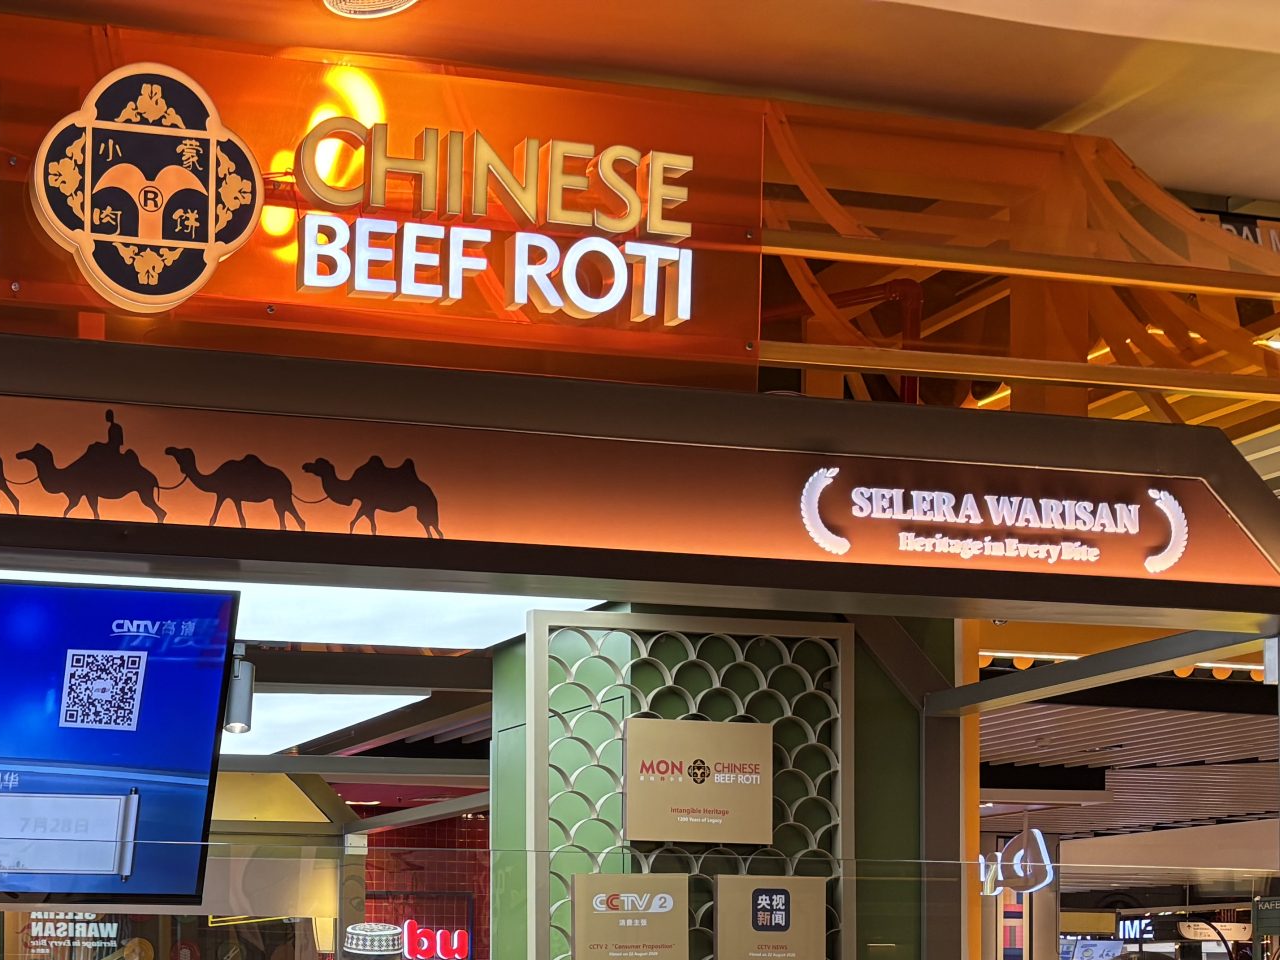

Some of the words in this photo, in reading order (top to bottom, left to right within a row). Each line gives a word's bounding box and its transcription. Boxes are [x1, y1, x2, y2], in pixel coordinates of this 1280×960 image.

[295, 116, 694, 240] CHINESE
[299, 214, 489, 301] BEEF
[511, 233, 693, 324] ROTI
[851, 487, 982, 525] SELERA
[984, 495, 1140, 535] WARISAN
[899, 532, 984, 560] Heritage
[985, 538, 1005, 557] in
[1004, 539, 1061, 564] Every
[1062, 542, 1100, 562] Bite
[111, 620, 160, 634] CNTV
[162, 620, 195, 636] 高清
[639, 759, 683, 775] MON
[714, 762, 760, 774] CHINESE
[714, 774, 737, 784] BEEF
[738, 774, 760, 785] ROTI
[670, 807, 701, 815] Intangible
[703, 808, 729, 817] Heritage
[592, 893, 651, 911] CCTV
[757, 894, 785, 910] 央视
[757, 911, 785, 926] 新闻
